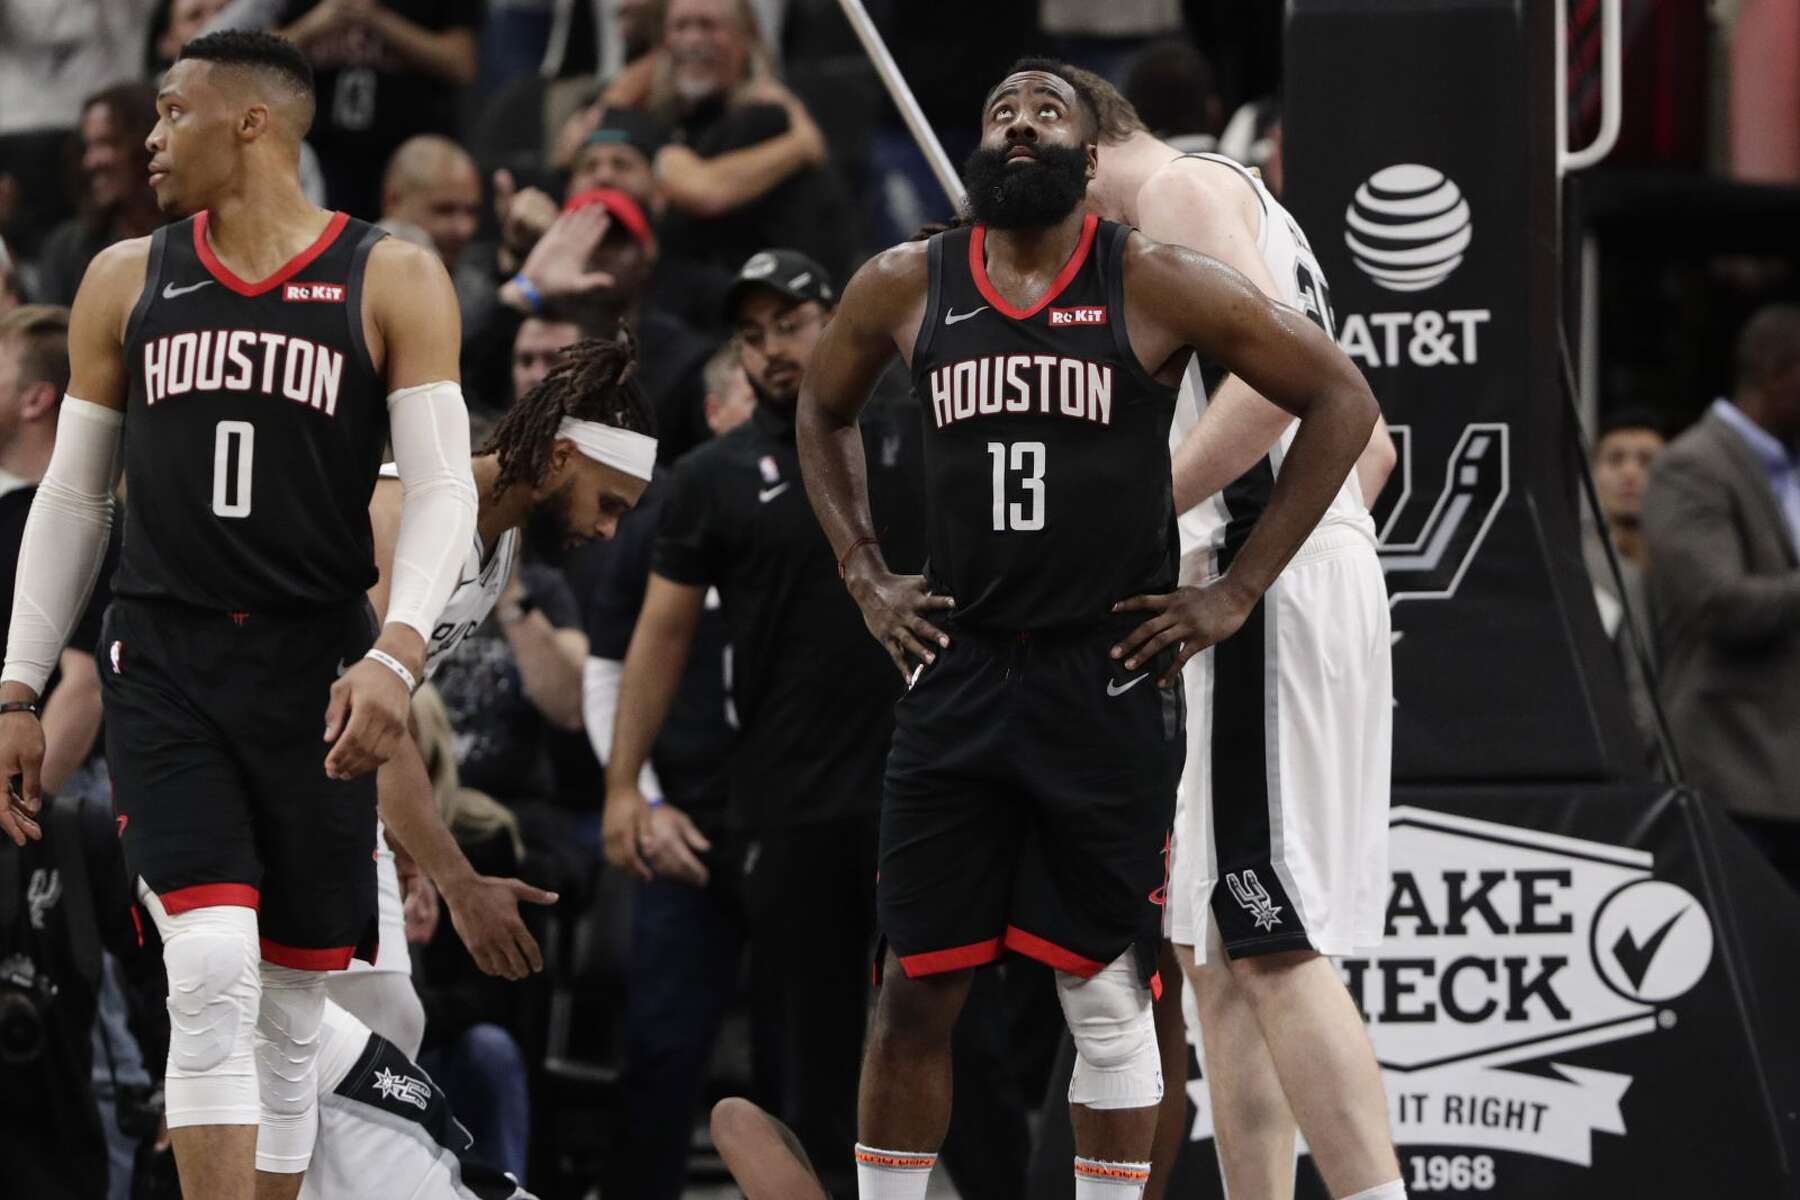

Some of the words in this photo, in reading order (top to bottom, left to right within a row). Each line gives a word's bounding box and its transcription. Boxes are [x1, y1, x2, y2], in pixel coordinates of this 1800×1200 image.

[144, 330, 344, 417] HOUSTON
[1338, 309, 1491, 368] AT&T
[930, 355, 1112, 429] HOUSTON
[212, 420, 255, 518] 0
[987, 441, 1046, 531] 13
[1384, 869, 1573, 936] AKE
[1400, 1094, 1428, 1123] IT
[1444, 1094, 1549, 1133] RIGHT
[1410, 1154, 1496, 1191] 1968
